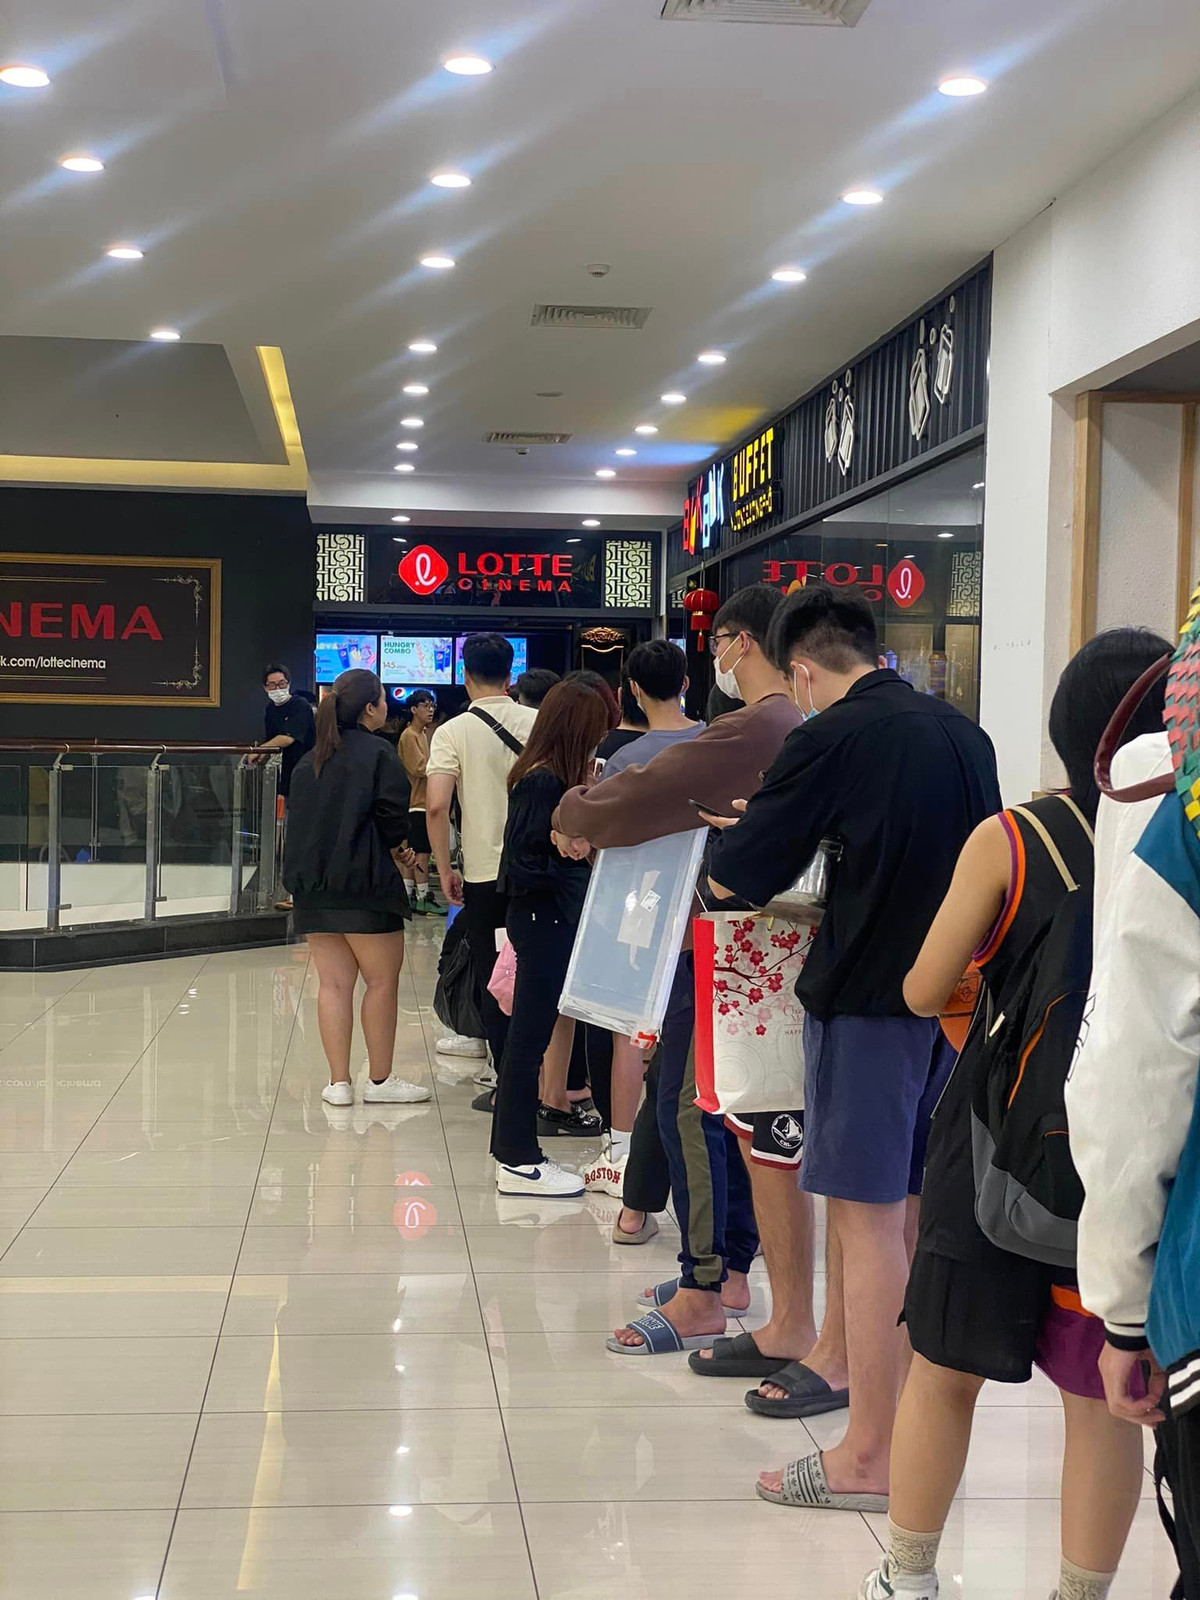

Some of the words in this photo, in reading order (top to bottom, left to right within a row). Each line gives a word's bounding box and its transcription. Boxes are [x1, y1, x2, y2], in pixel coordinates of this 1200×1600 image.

[733, 427, 774, 502] BUFFET
[458, 552, 573, 577] LOTTE
[458, 577, 572, 592] CINEMA
[584, 1167, 622, 1185] BOSTON
